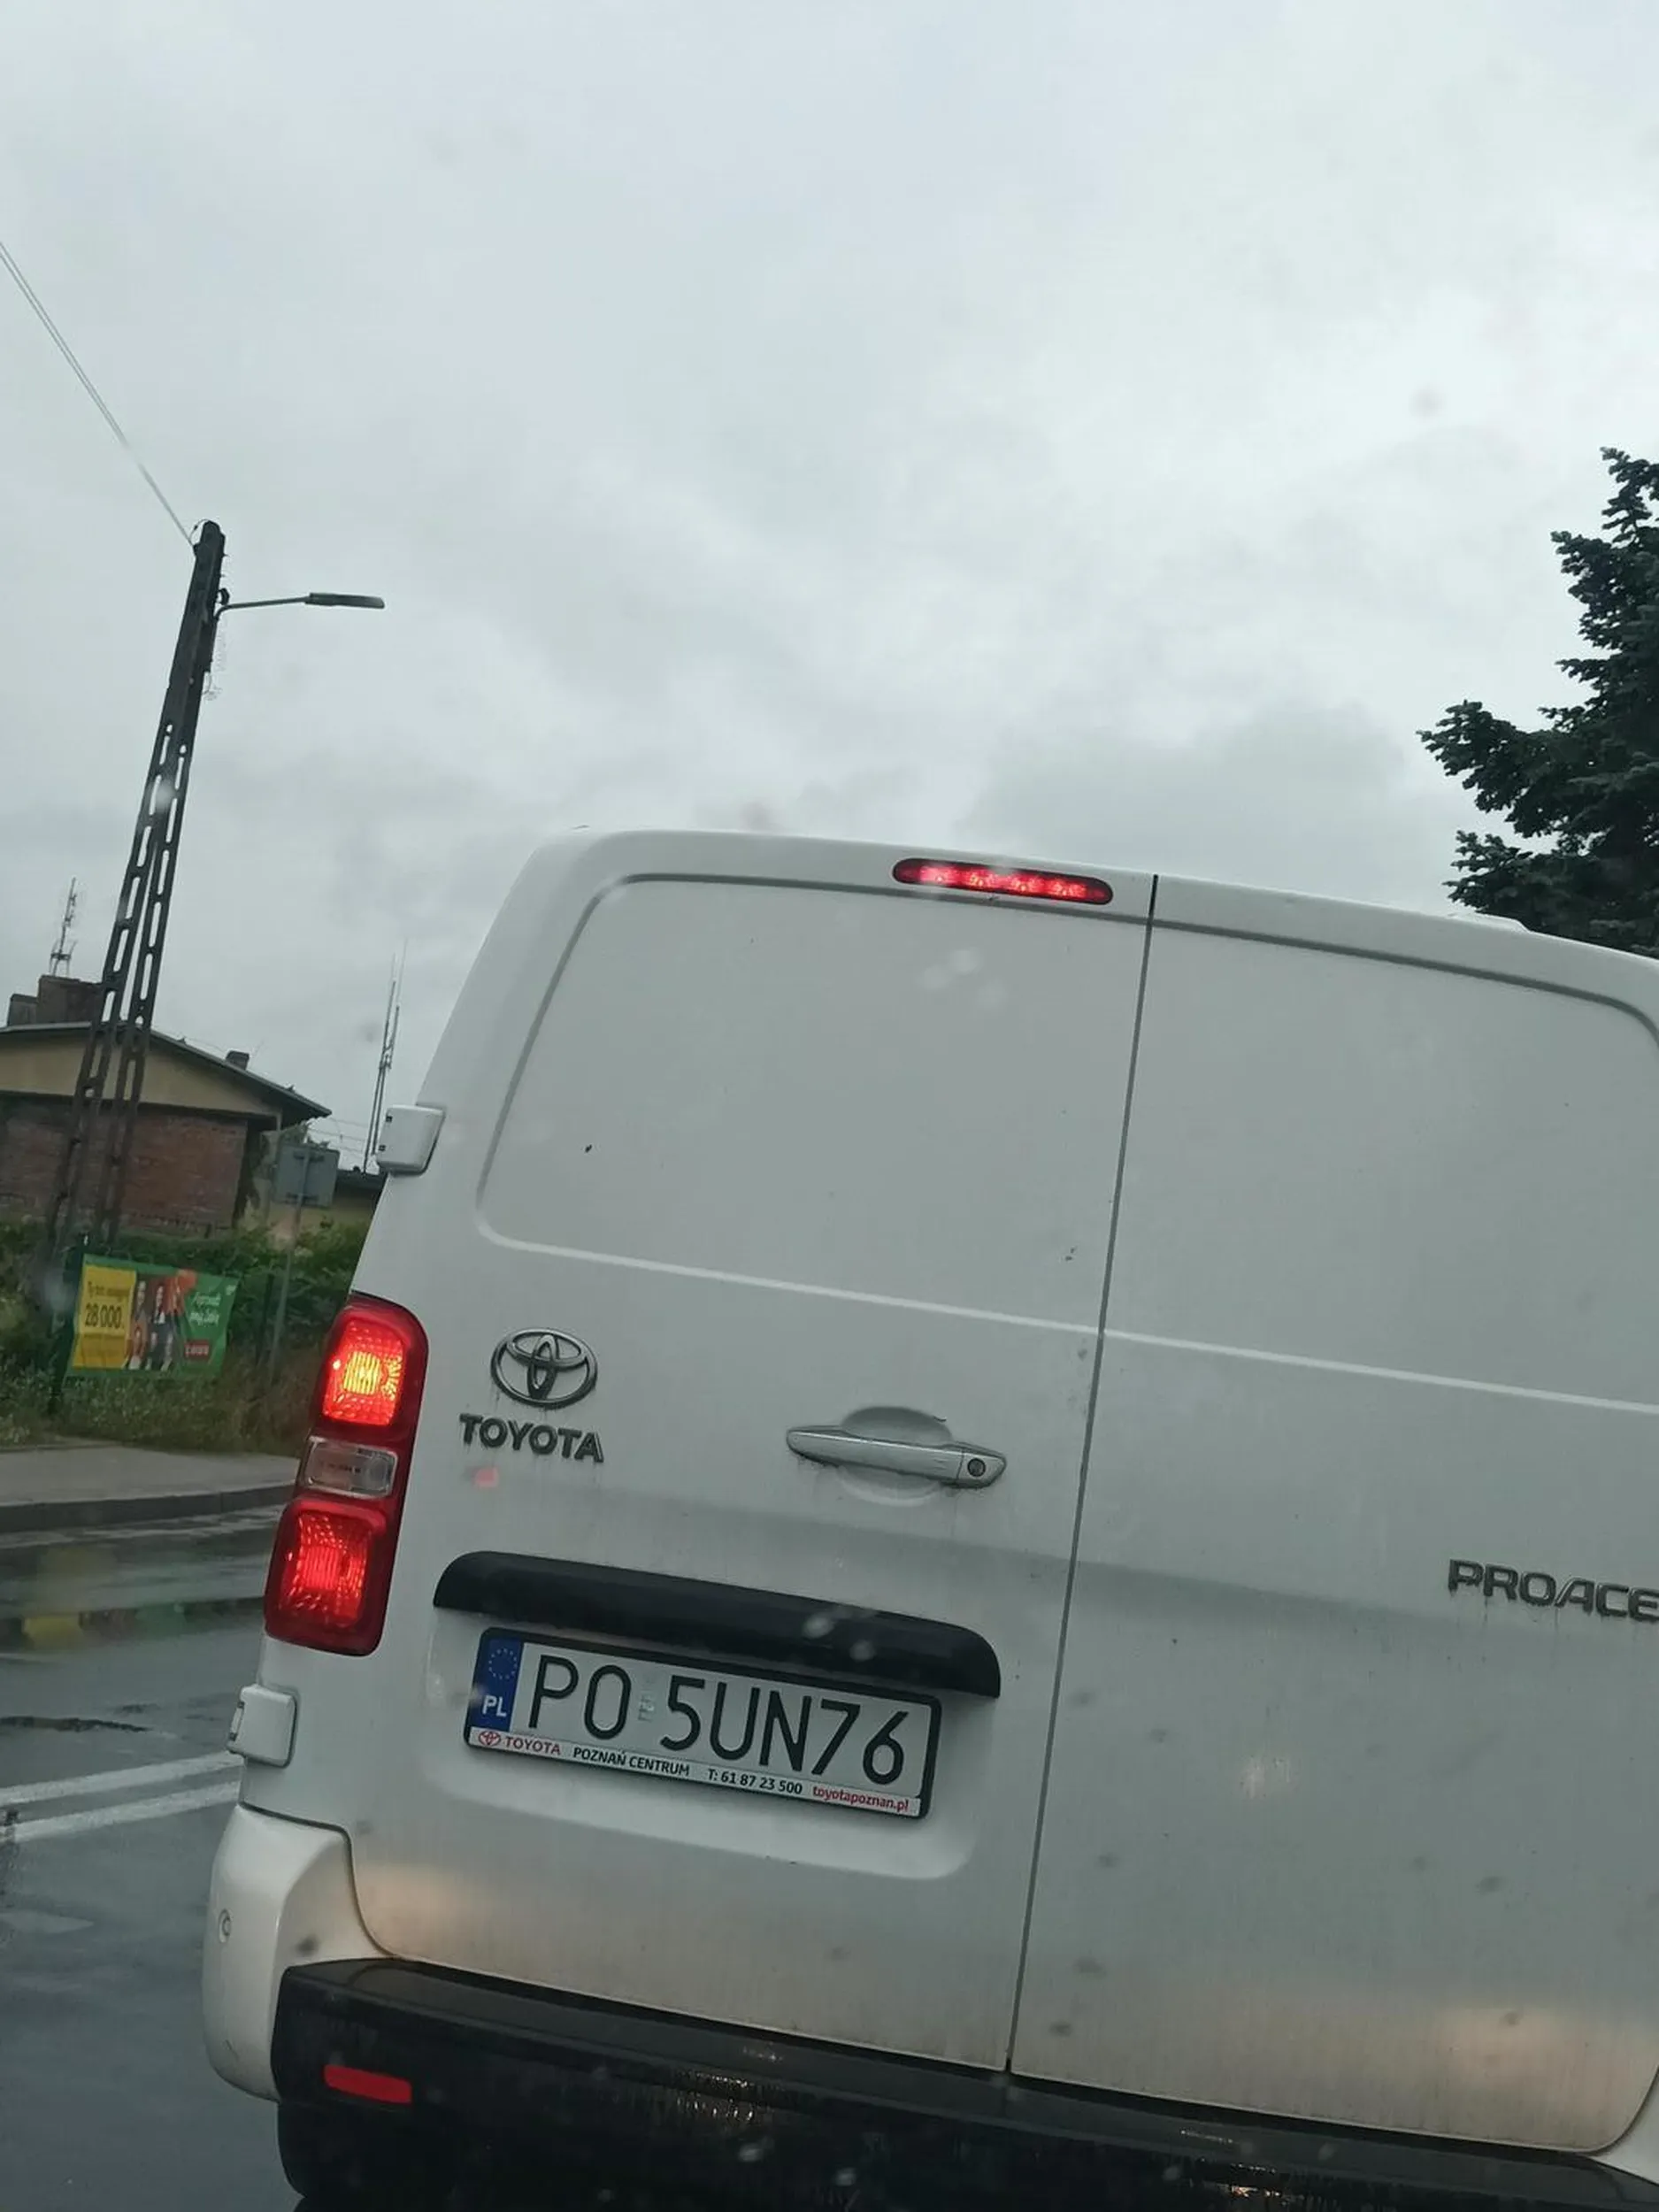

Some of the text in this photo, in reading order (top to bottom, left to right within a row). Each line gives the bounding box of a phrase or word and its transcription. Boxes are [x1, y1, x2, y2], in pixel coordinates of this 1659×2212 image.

[459, 1413, 604, 1463] TOYOTA
[1448, 1558, 1659, 1621] PROACE
[482, 1695, 507, 1717] PL
[528, 1655, 910, 1786] PO 5UN76
[503, 1735, 910, 1812] TOYOTA POZNAŃ CENTRUM T: 61 87 23 500 toyotapoznan.pl
